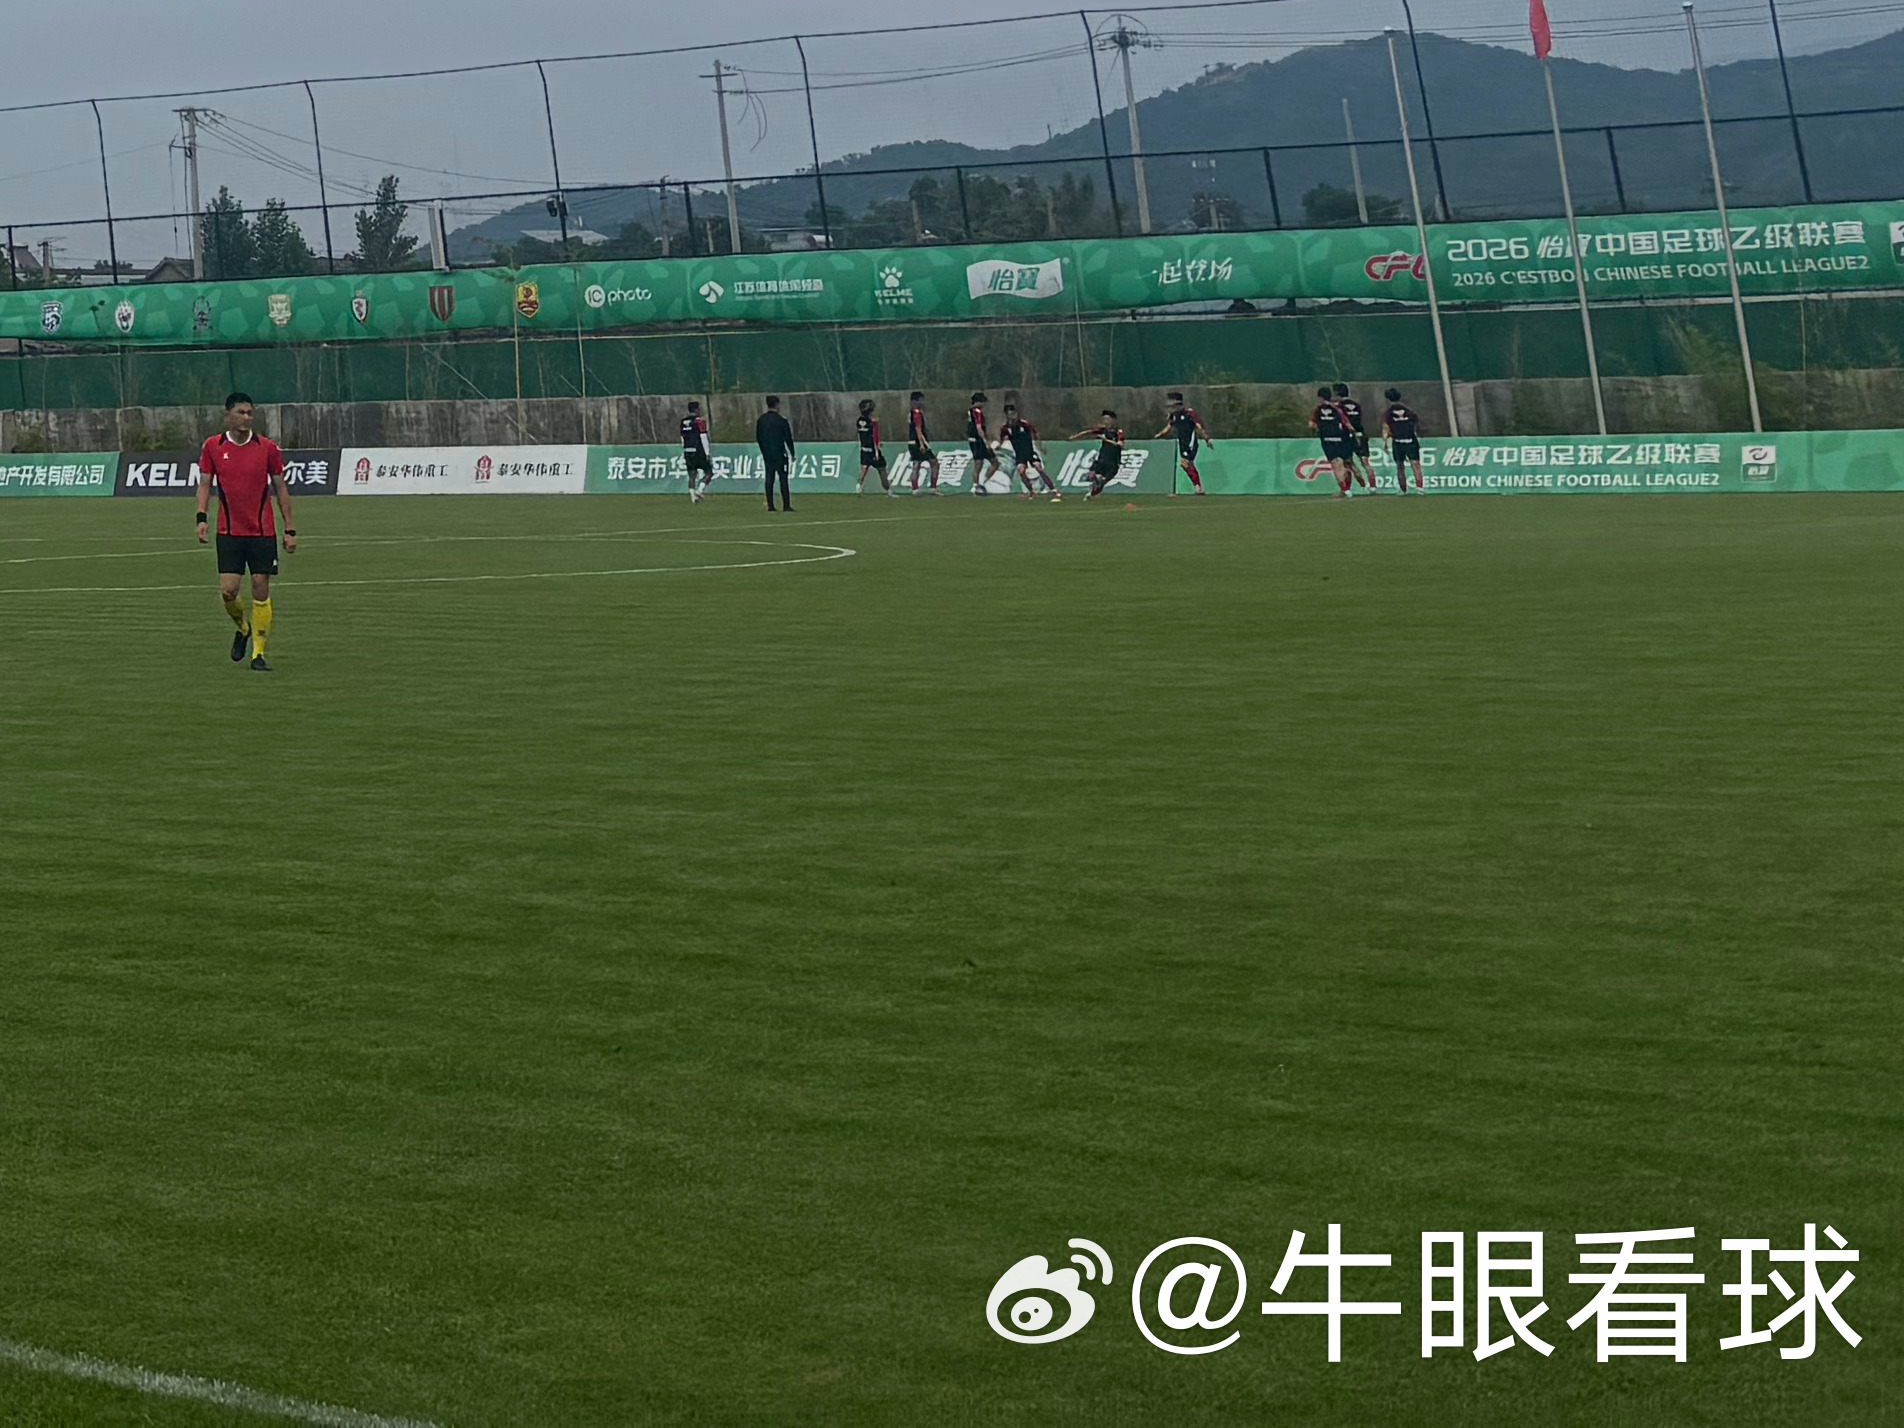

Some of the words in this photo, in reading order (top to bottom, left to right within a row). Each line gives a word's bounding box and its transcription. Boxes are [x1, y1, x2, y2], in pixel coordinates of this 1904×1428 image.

[1446, 239, 1530, 262] 2026
[1453, 272, 1494, 287] 2026
[1594, 261, 1673, 282] CHINESE
[1781, 255, 1871, 274] LEAGUE2
[608, 287, 652, 307] photo
[1487, 474, 1554, 489] CHINESE
[1557, 473, 1641, 488] FOOTBALL
[1645, 472, 1720, 487] LEAGUE2
